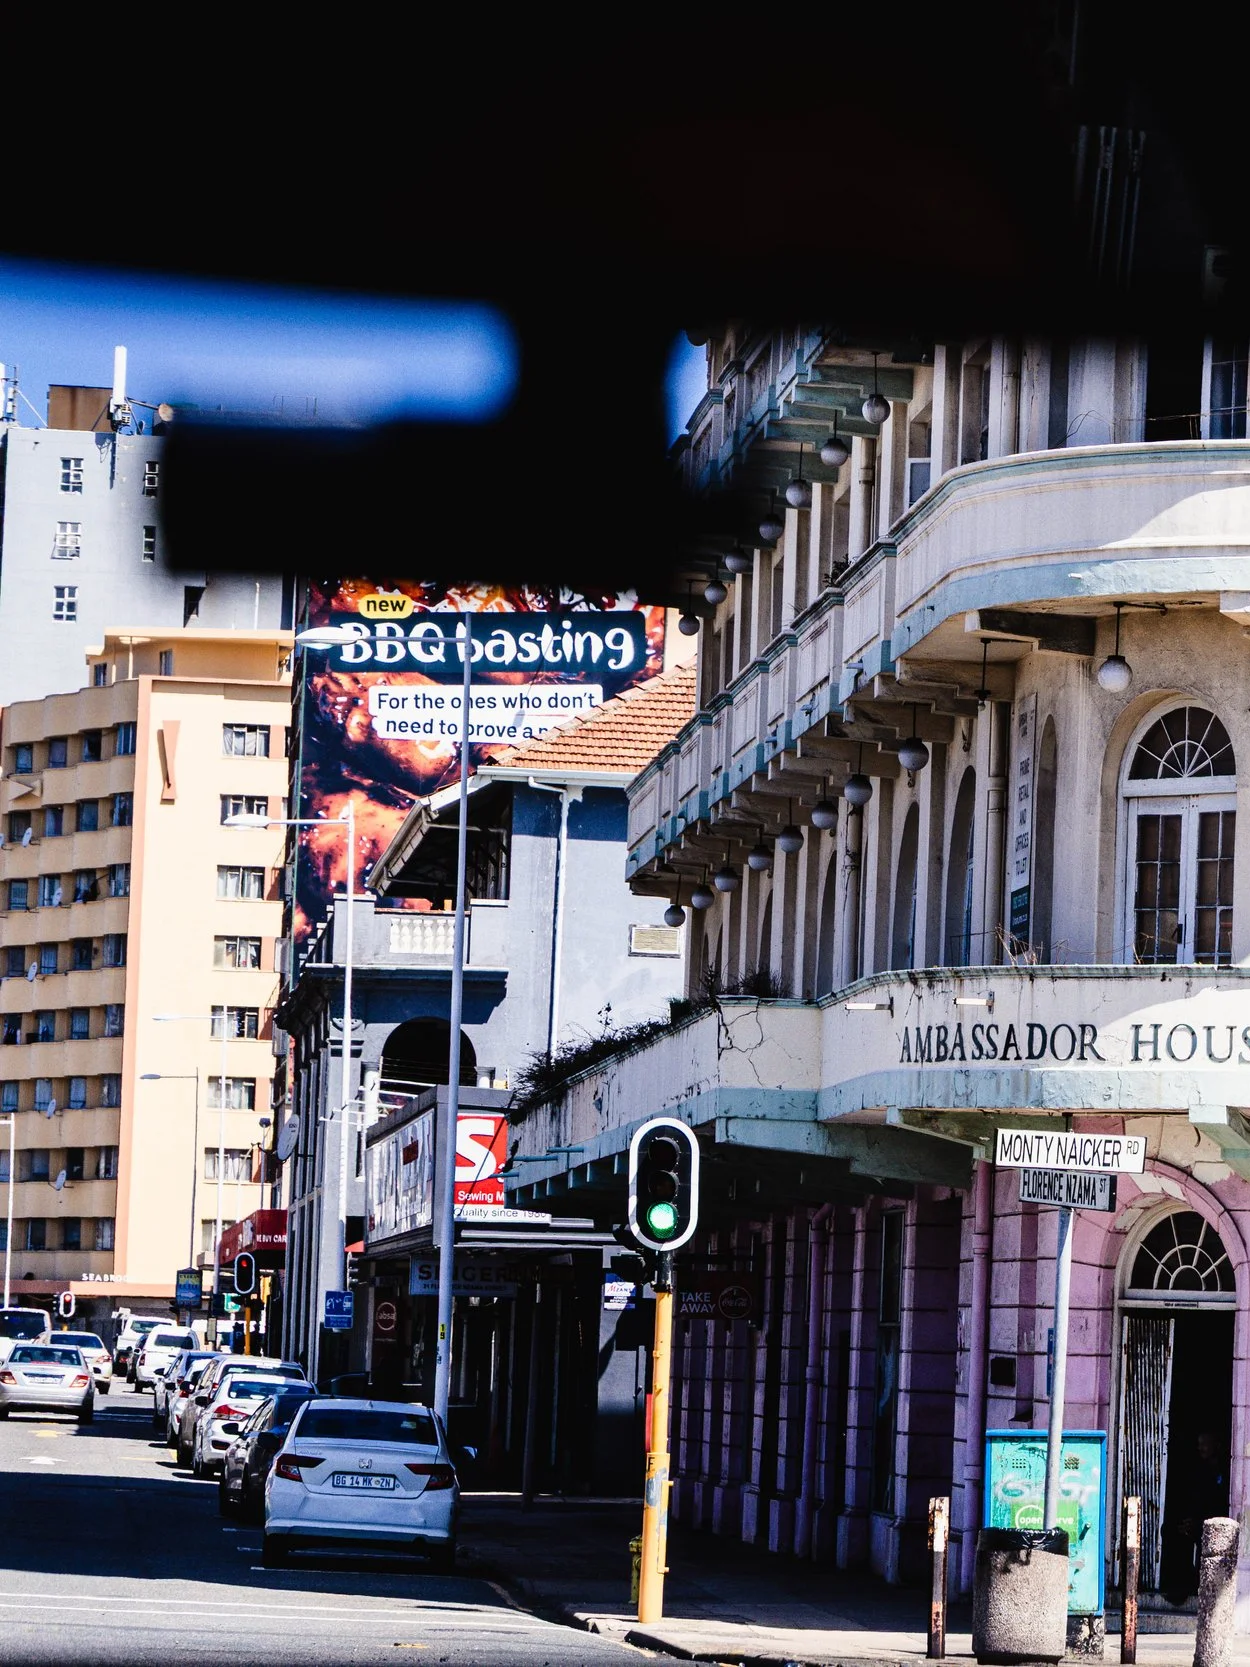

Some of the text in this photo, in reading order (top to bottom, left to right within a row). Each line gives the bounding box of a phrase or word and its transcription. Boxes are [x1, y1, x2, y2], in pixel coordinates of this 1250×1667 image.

[366, 597, 406, 612] new
[340, 620, 635, 669] BBQ basting
[378, 692, 408, 709] For
[414, 692, 445, 709] the
[502, 692, 541, 709] who
[547, 692, 595, 709] don't
[386, 718, 433, 734] need
[439, 720, 458, 735] to
[522, 726, 533, 739] a
[900, 1023, 1106, 1063] AMBASSADOR
[1000, 1134, 1139, 1168] MONTY NAICKER RD
[1022, 1169, 1107, 1206] FLORENCE NZAMA ST
[458, 1190, 493, 1203] Sewing
[491, 1209, 519, 1217] since
[679, 1291, 712, 1303] TAKE
[679, 1303, 717, 1313] AWAY
[350, 1475, 360, 1486] 14
[380, 1477, 391, 1488] ZN
